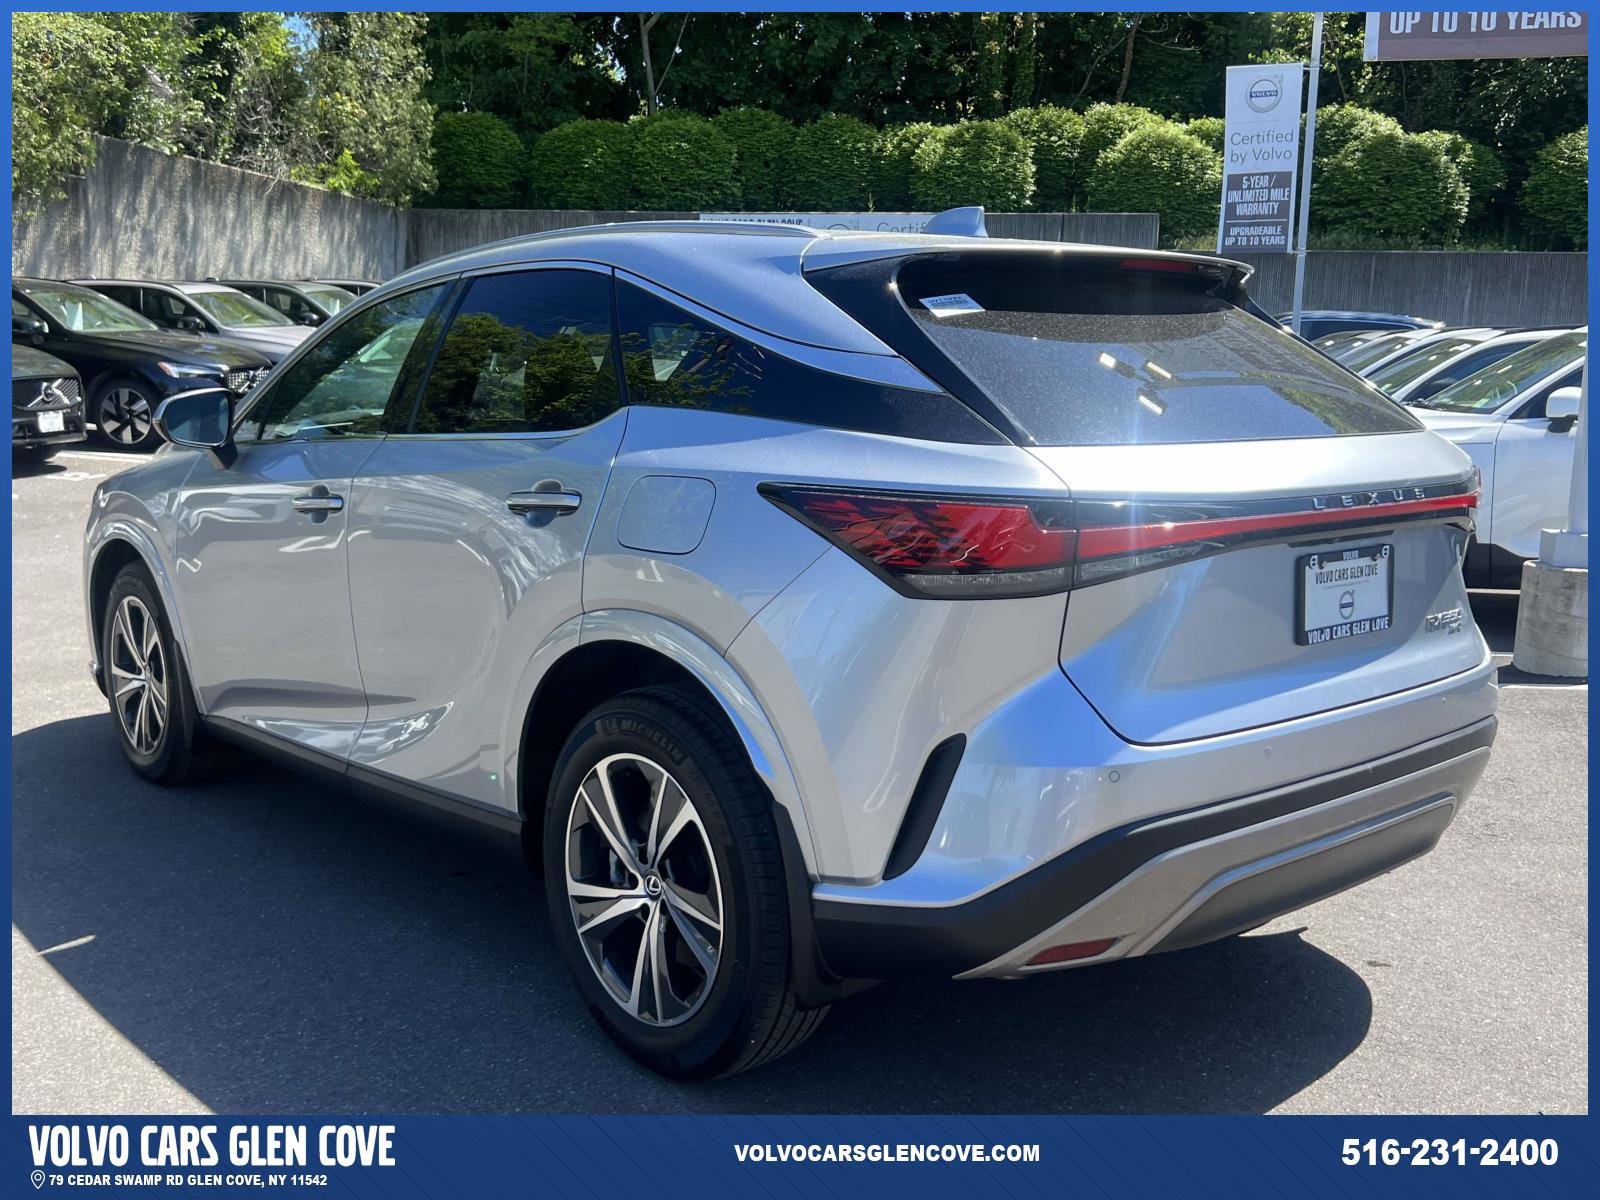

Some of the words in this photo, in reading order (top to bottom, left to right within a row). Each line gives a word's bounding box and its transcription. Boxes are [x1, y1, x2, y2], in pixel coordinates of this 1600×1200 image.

[1390, 12, 1421, 34] UP
[1507, 12, 1582, 30] YEARS
[1230, 129, 1294, 146] Certified
[1230, 149, 1247, 166] by
[1252, 147, 1292, 161] Volvo
[1242, 175, 1269, 189] 5-YEAR
[1227, 188, 1268, 203] UNLIMITED
[1270, 188, 1290, 201] MILE
[1236, 202, 1279, 216] WARRANTY
[1230, 226, 1282, 236] UPGRADEABLE
[1225, 237, 1235, 246] UP
[1237, 237, 1247, 246] TO
[1249, 236, 1259, 246] 10
[1261, 236, 1285, 245] YEARS
[1312, 488, 1425, 509] LEXUS
[1343, 550, 1359, 561] VOLVO
[1315, 570, 1333, 584] VOLVO
[1335, 567, 1348, 581] CARS
[1350, 565, 1364, 579] GLEN
[1365, 563, 1378, 577] COVE
[1308, 628, 1330, 644] VOLVO
[1332, 624, 1350, 639] CARS
[1352, 620, 1370, 635] GLEN
[622, 720, 683, 762] MICHELIN
